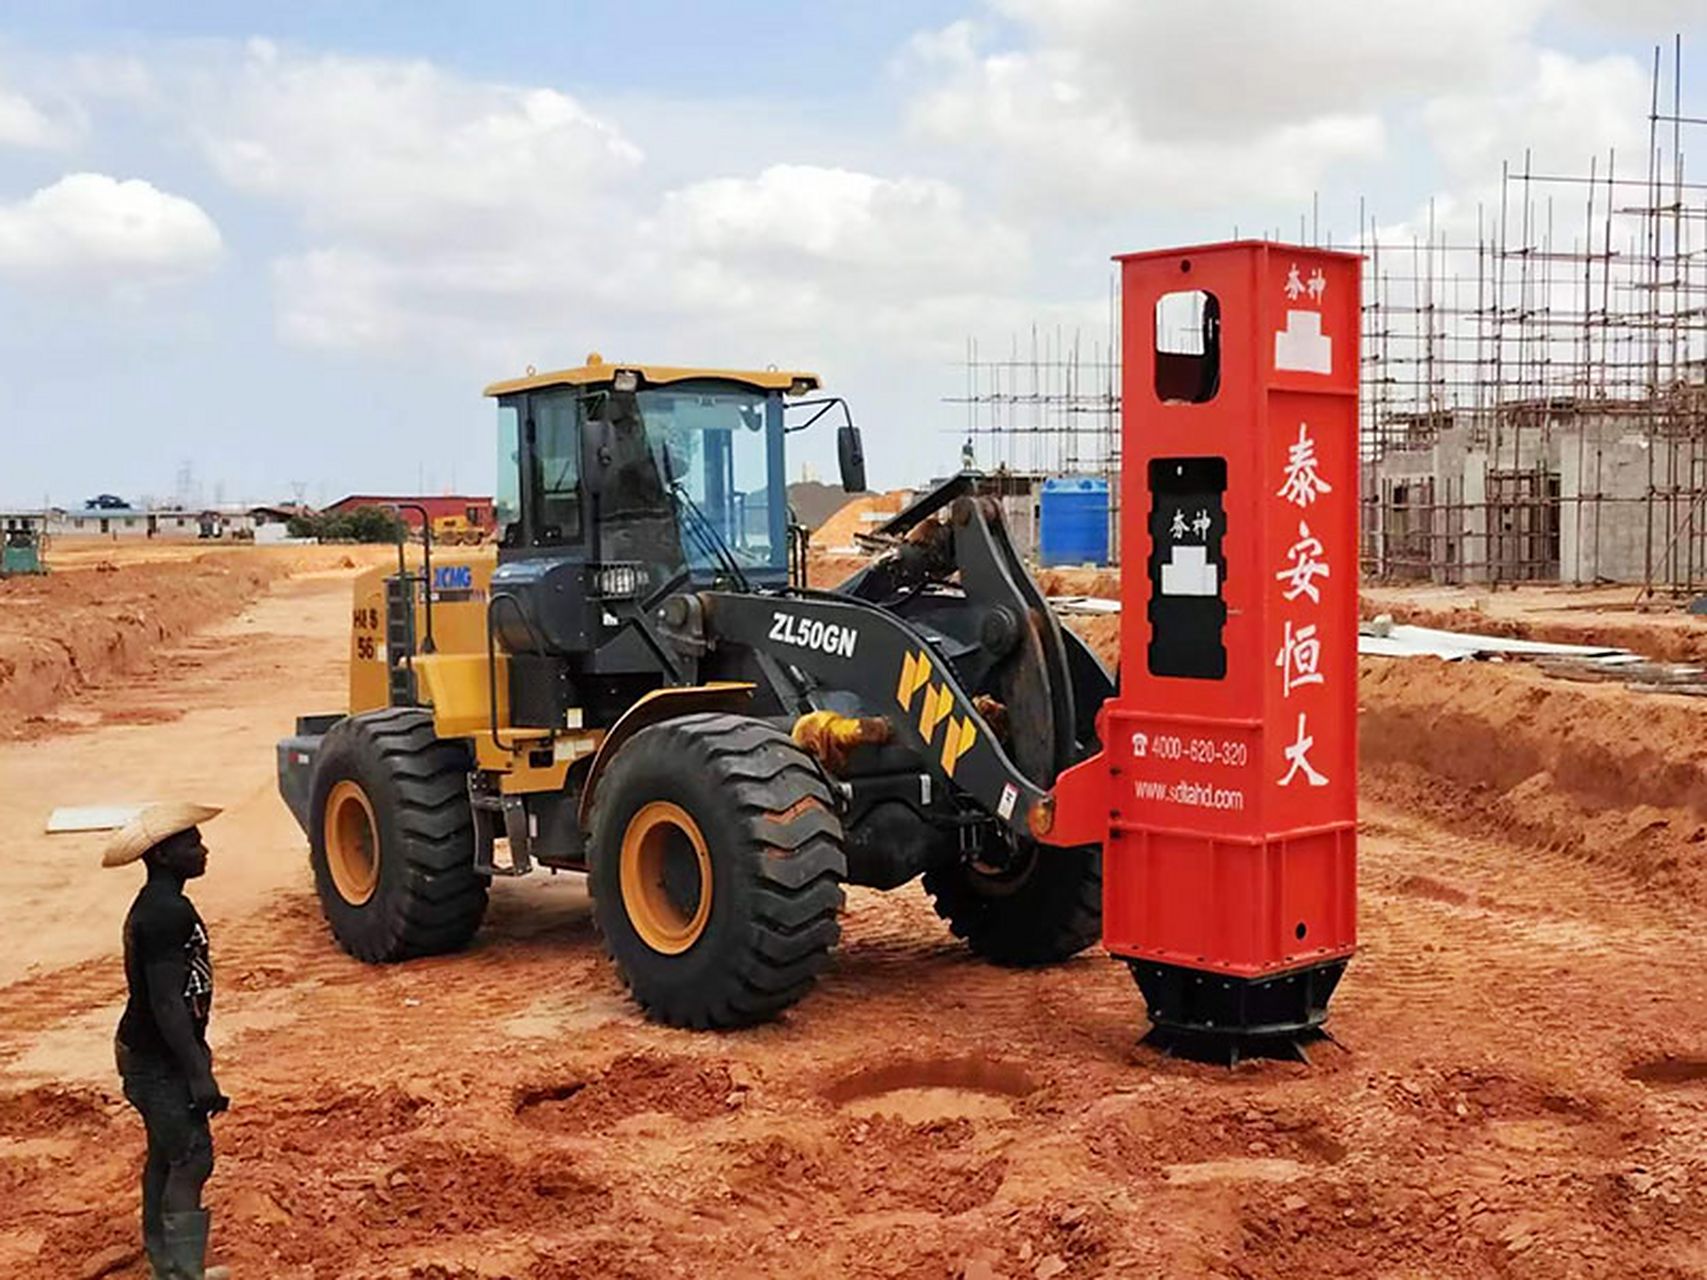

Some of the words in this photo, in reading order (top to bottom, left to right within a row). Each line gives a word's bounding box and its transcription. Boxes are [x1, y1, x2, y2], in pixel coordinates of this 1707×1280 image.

[769, 612, 857, 658] ZL50GN
[1276, 421, 1332, 787] 泰安恒大
